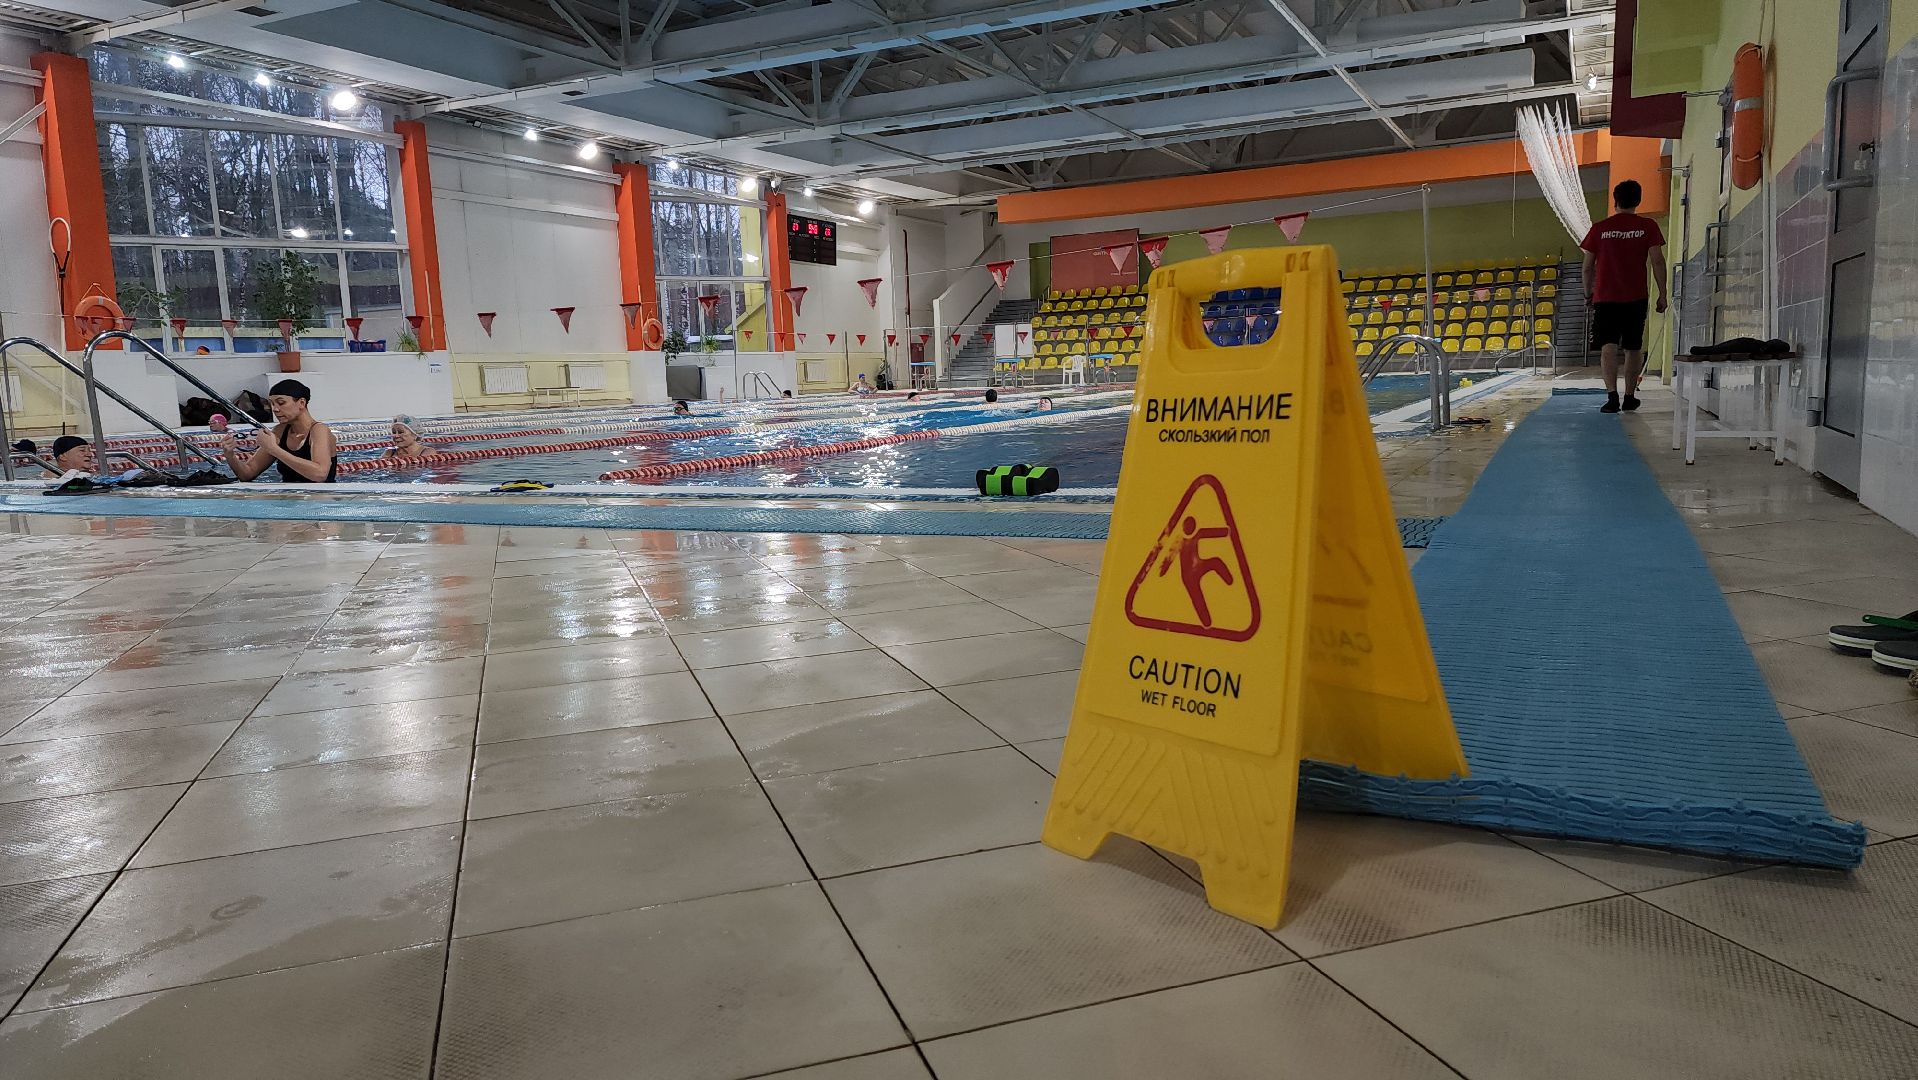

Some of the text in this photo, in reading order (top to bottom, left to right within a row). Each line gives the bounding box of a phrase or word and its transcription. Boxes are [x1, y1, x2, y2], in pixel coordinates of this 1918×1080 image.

[1145, 393, 1293, 423] ВНИМАНИЕ
[1158, 427, 1271, 443] СКОЛЬЗКИЙ ПОЛ
[1129, 655, 1242, 699] CAUTION
[1141, 689, 1216, 718] WET FLOOR
